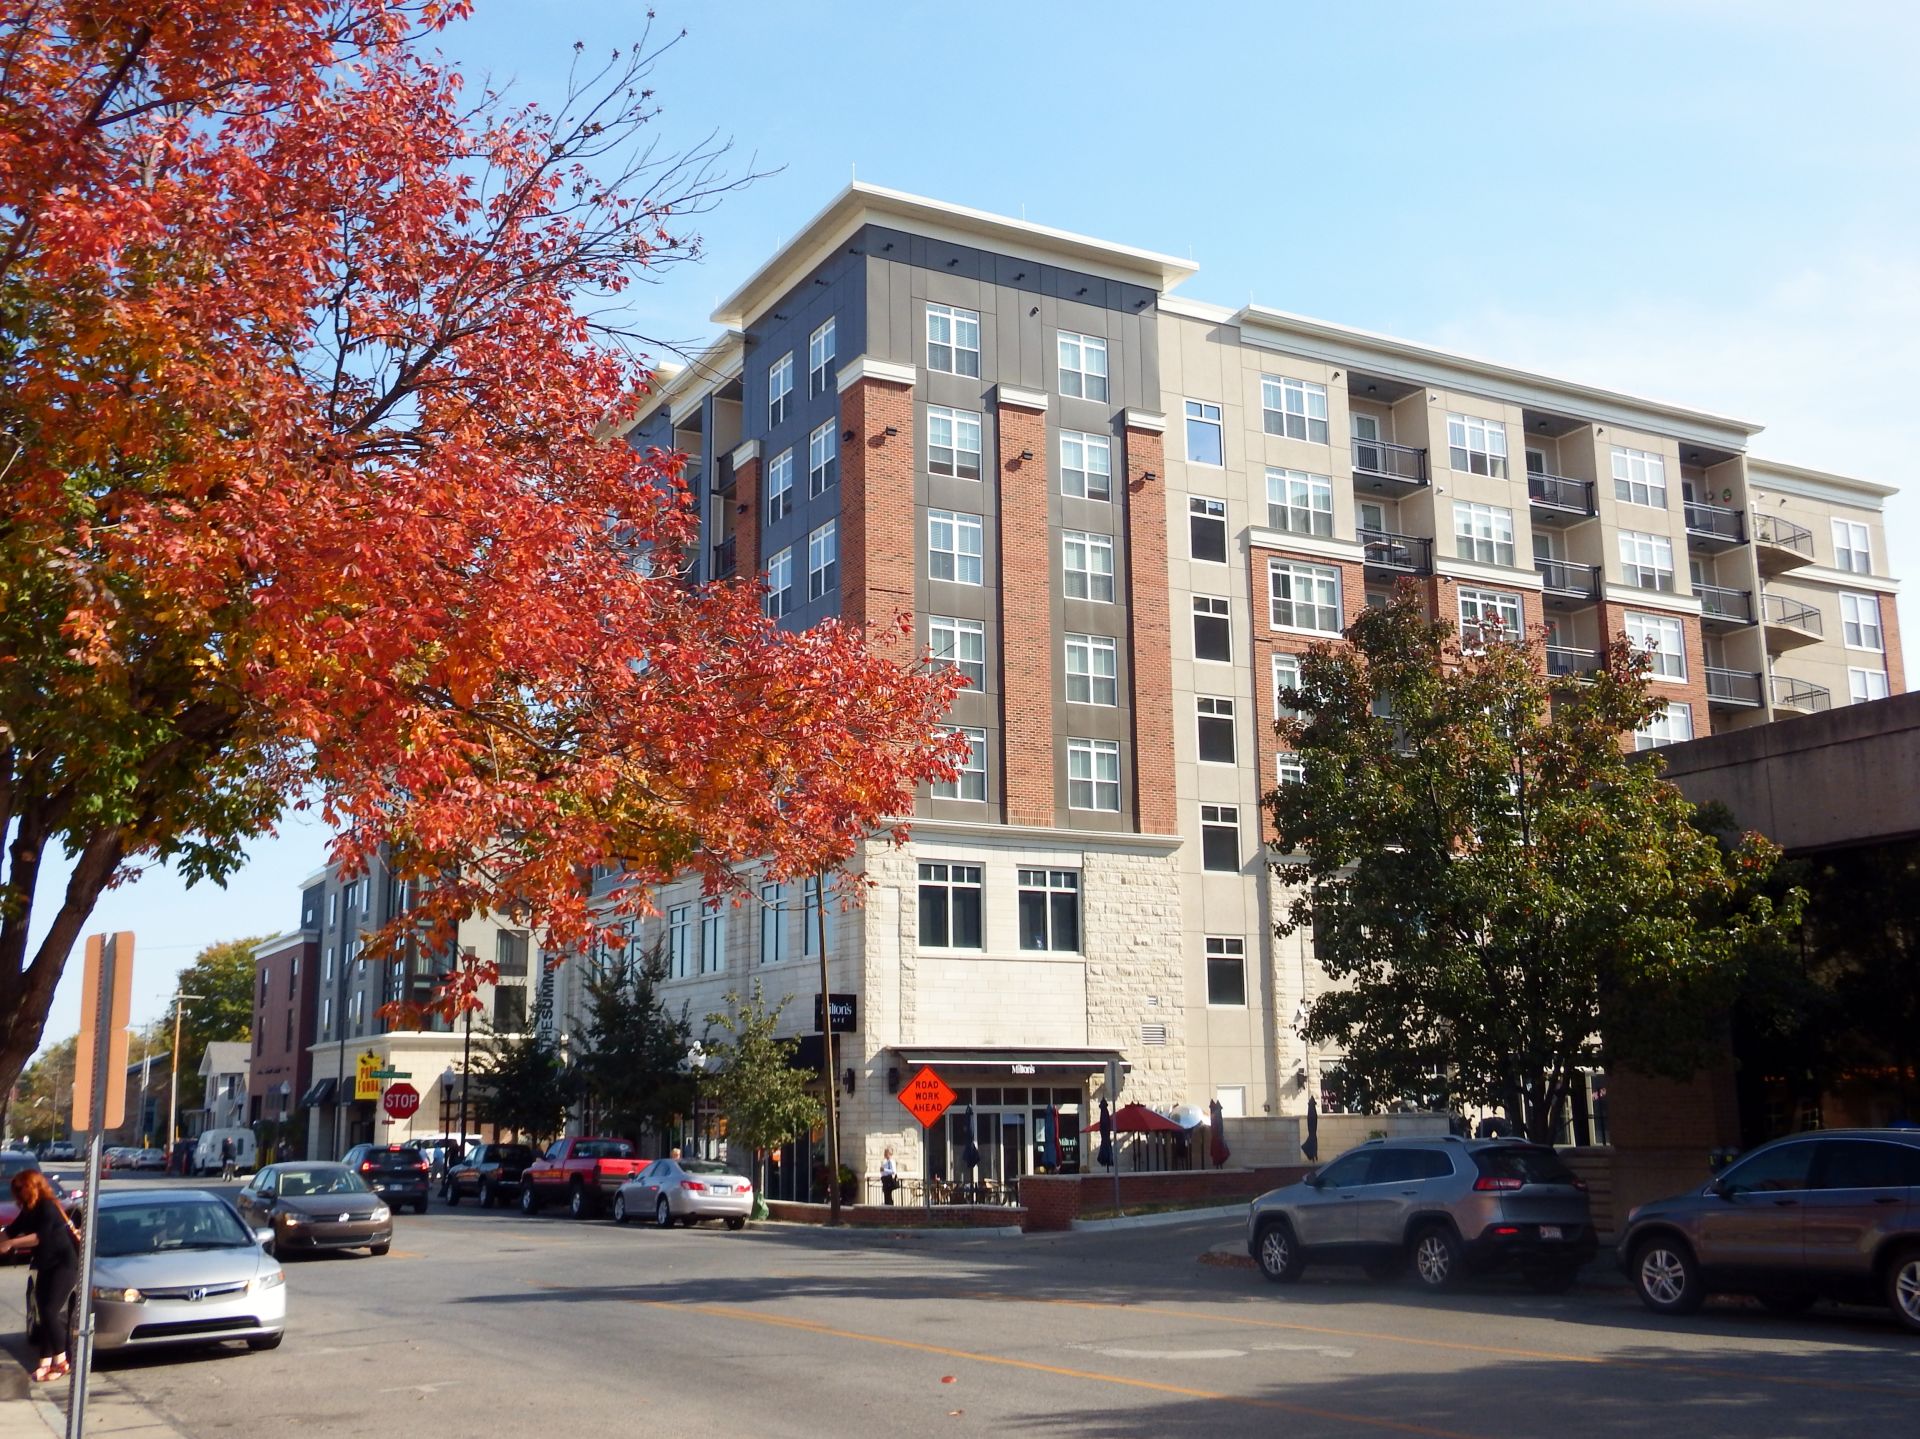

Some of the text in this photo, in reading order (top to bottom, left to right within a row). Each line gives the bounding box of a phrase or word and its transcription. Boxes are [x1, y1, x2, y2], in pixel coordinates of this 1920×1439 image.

[821, 1002, 852, 1015] ilton's
[915, 1081, 939, 1089] ROAD
[385, 1094, 418, 1108] STOP
[915, 1092, 940, 1101] WORK
[913, 1103, 943, 1112] AHEAD
